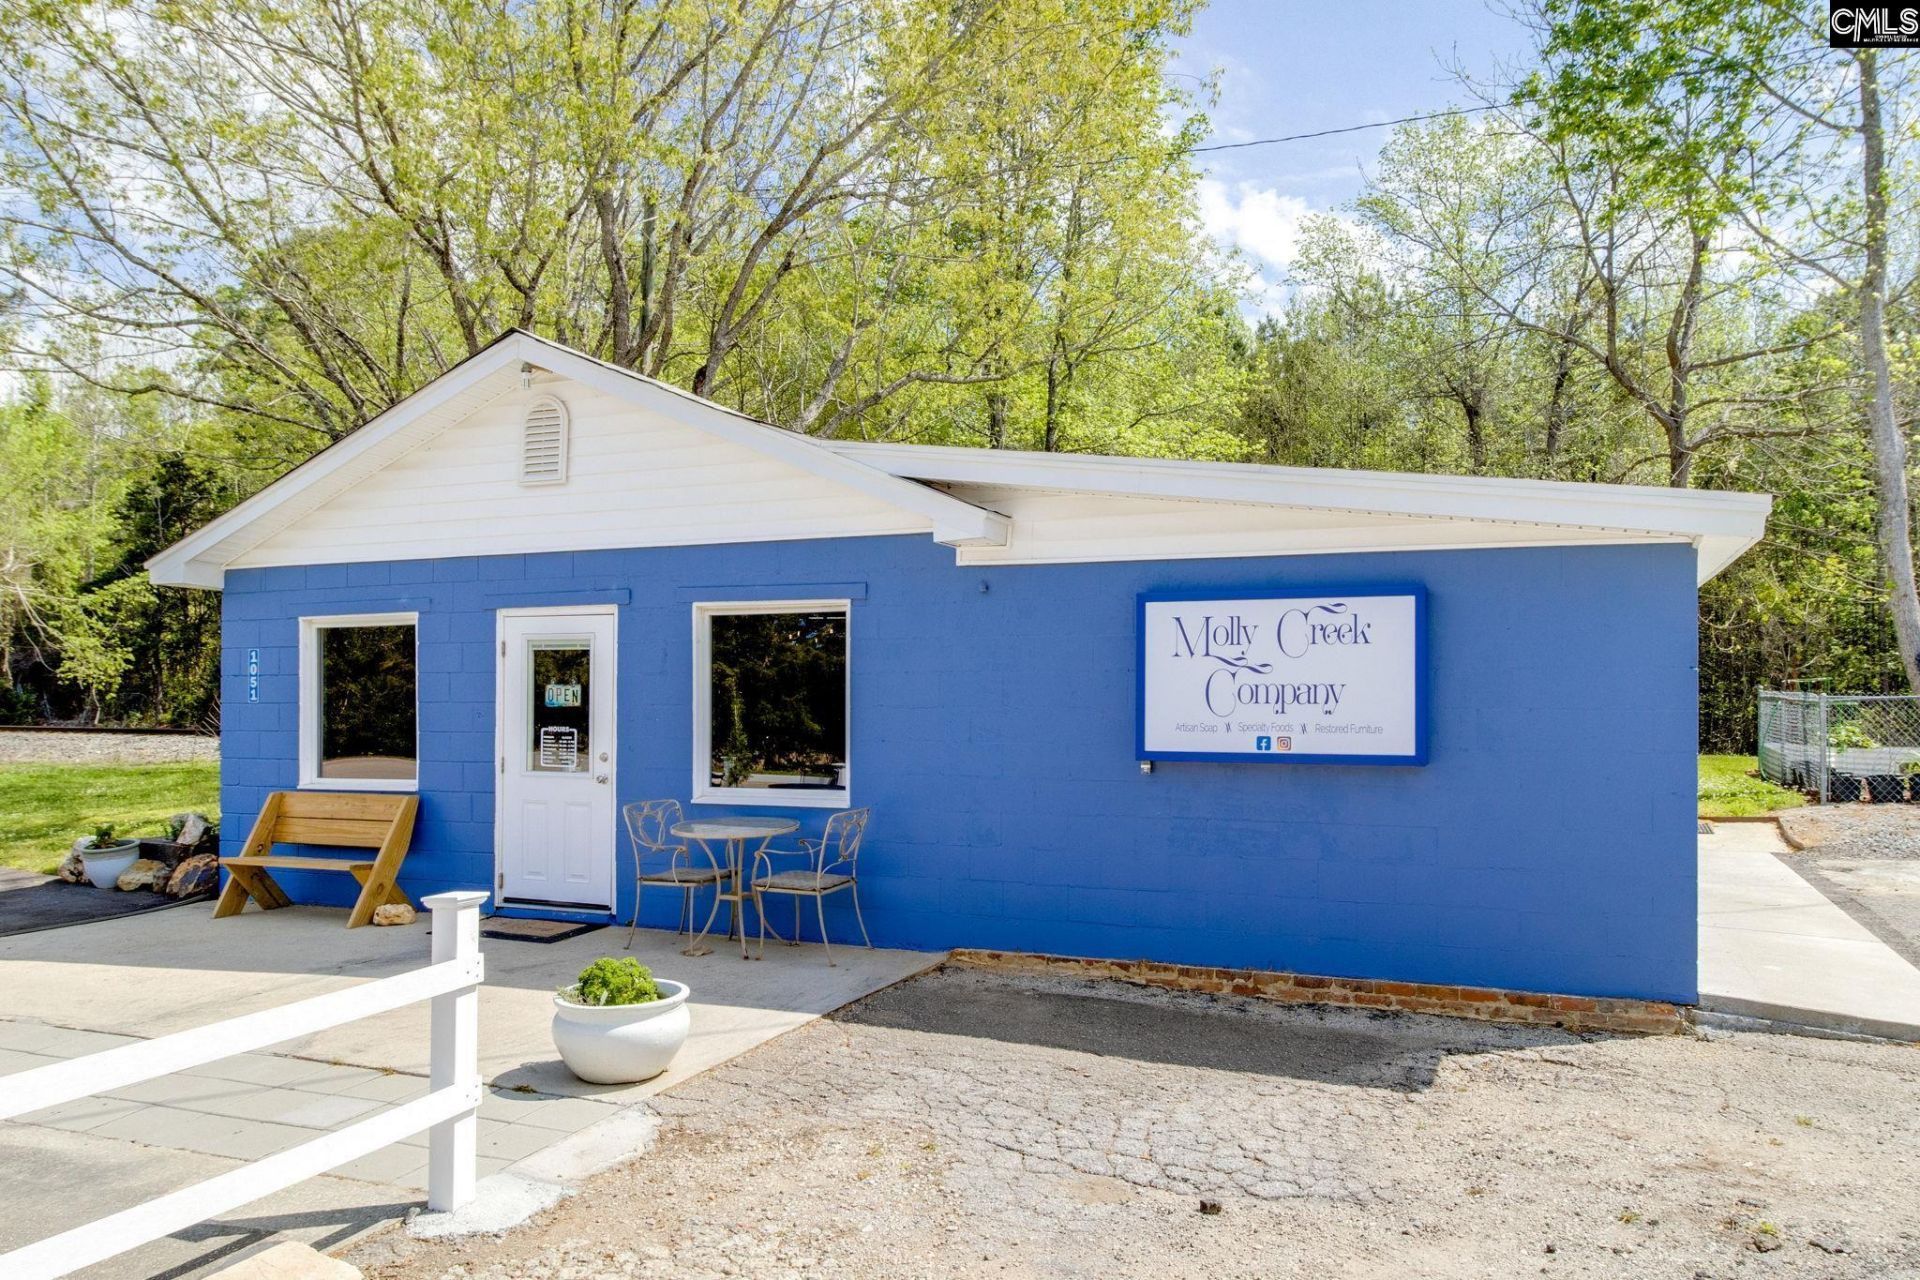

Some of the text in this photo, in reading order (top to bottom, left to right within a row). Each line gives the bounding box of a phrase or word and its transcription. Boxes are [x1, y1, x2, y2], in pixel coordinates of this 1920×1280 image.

[1172, 602, 1372, 667] Molly Creek
[250, 650, 258, 701] 1051
[547, 687, 580, 703] OPEN
[1205, 666, 1347, 718] Company
[1175, 722, 1217, 735] Artisan Soap
[1238, 722, 1294, 735] Specialty Foods
[1315, 723, 1384, 735] Restored Furniture
